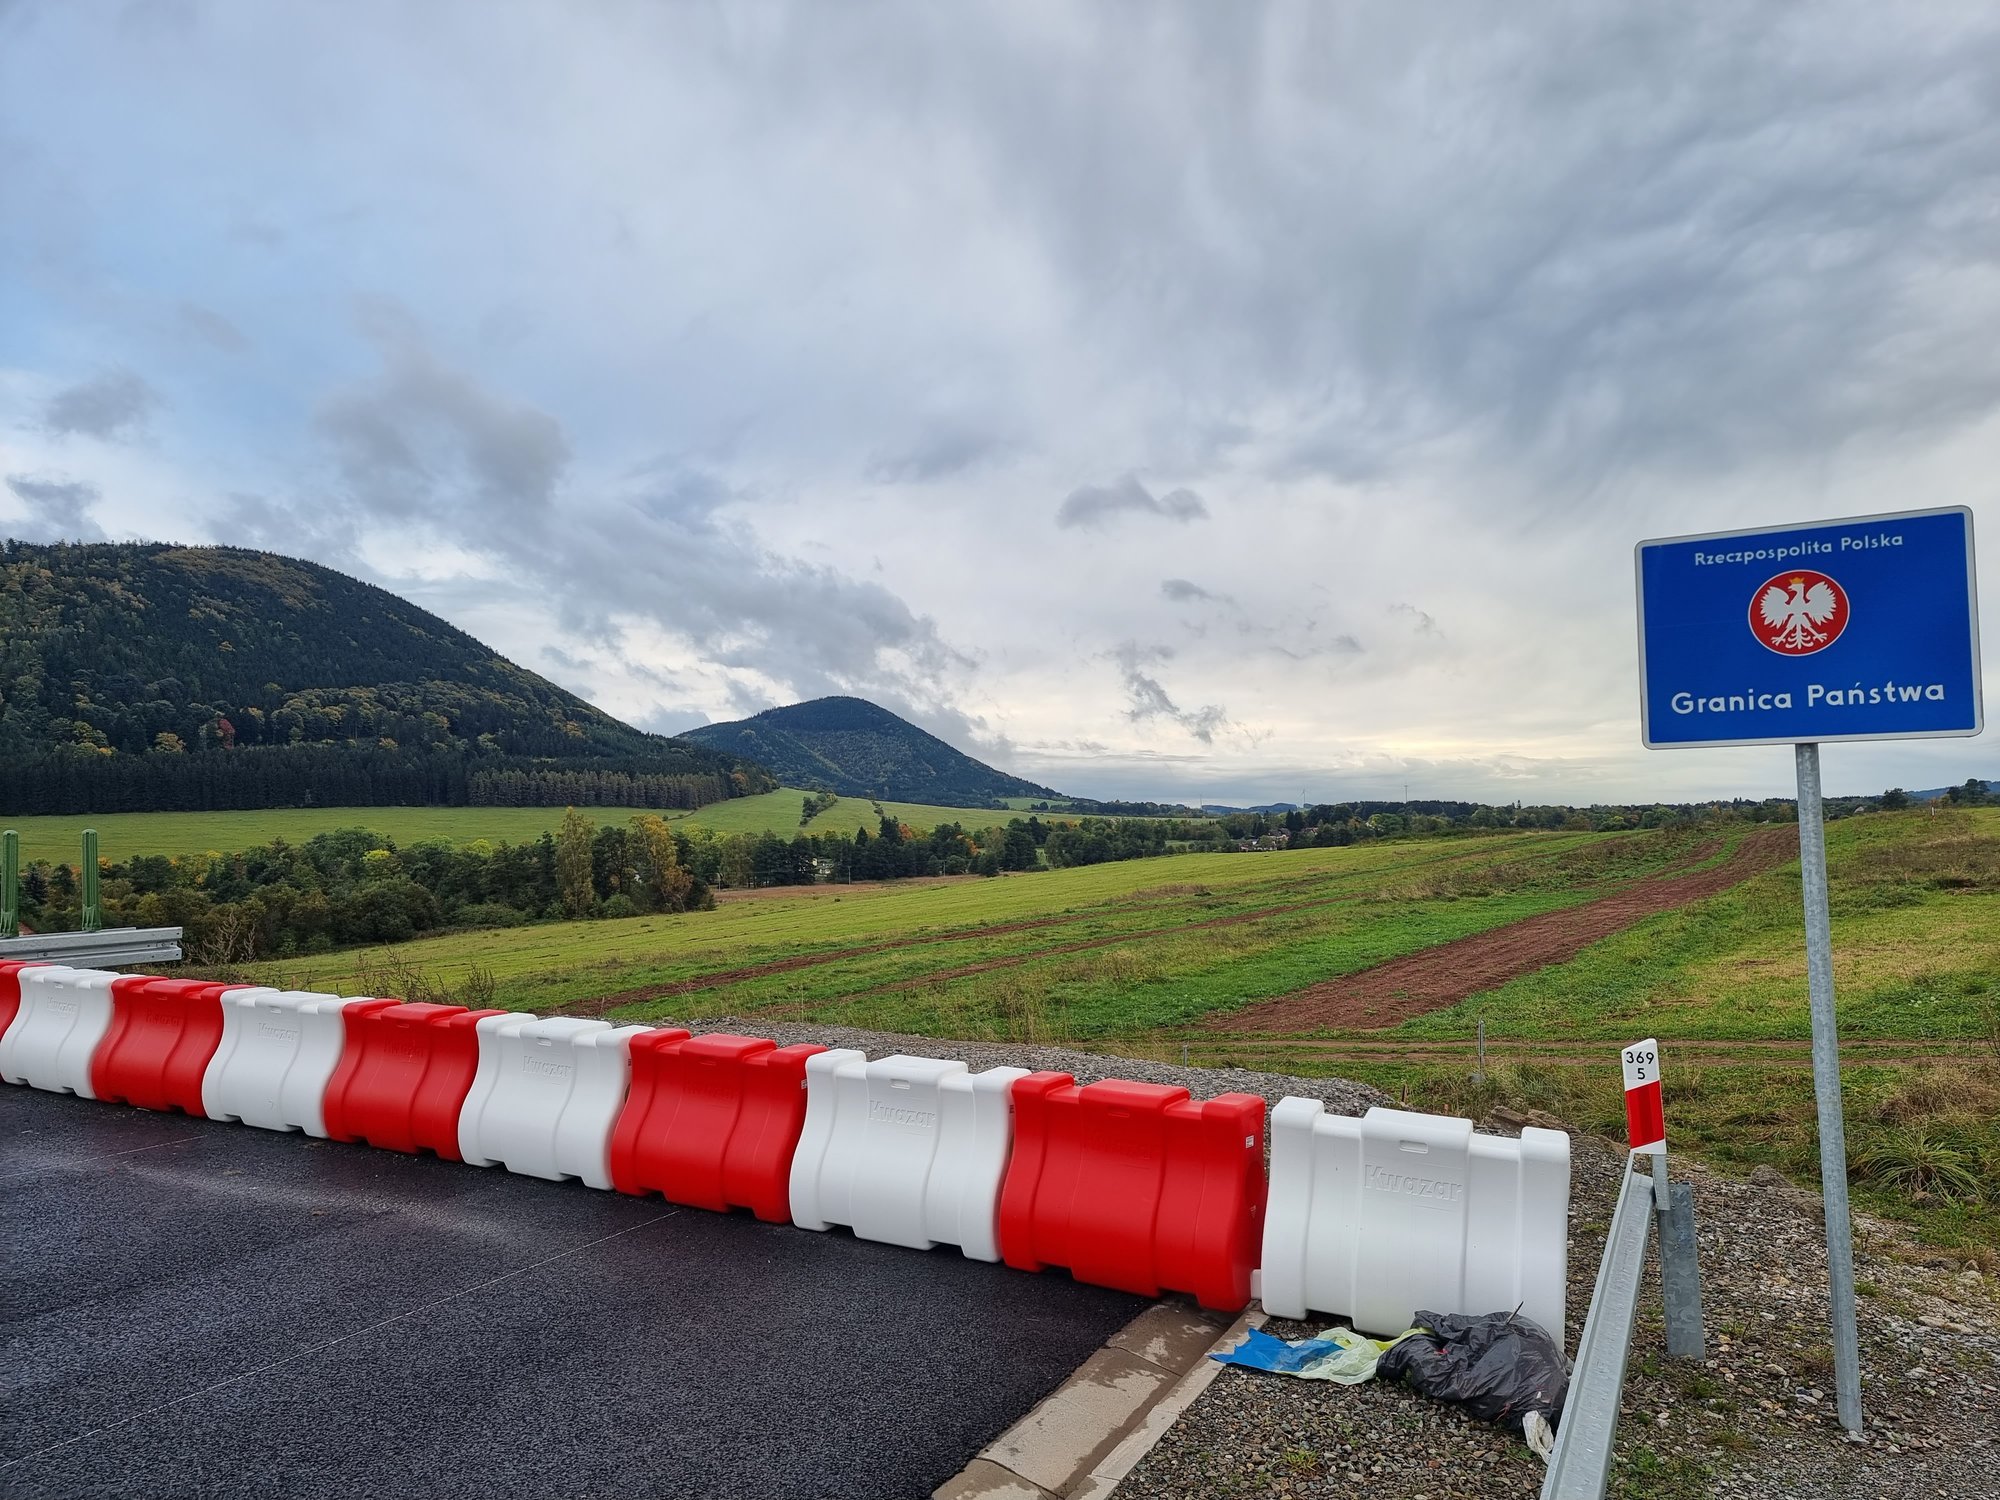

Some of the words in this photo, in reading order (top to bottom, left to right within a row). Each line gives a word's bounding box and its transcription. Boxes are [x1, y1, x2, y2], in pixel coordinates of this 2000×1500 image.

[1694, 540, 1833, 566] Rzeczpospolita
[1840, 533, 1904, 551] Polska
[1671, 688, 1793, 715] Granica
[1806, 681, 1945, 707] Państwa
[1625, 1051, 1655, 1065] 369
[1637, 1067, 1646, 1080] 5
[1363, 1163, 1464, 1202] Kwazar
